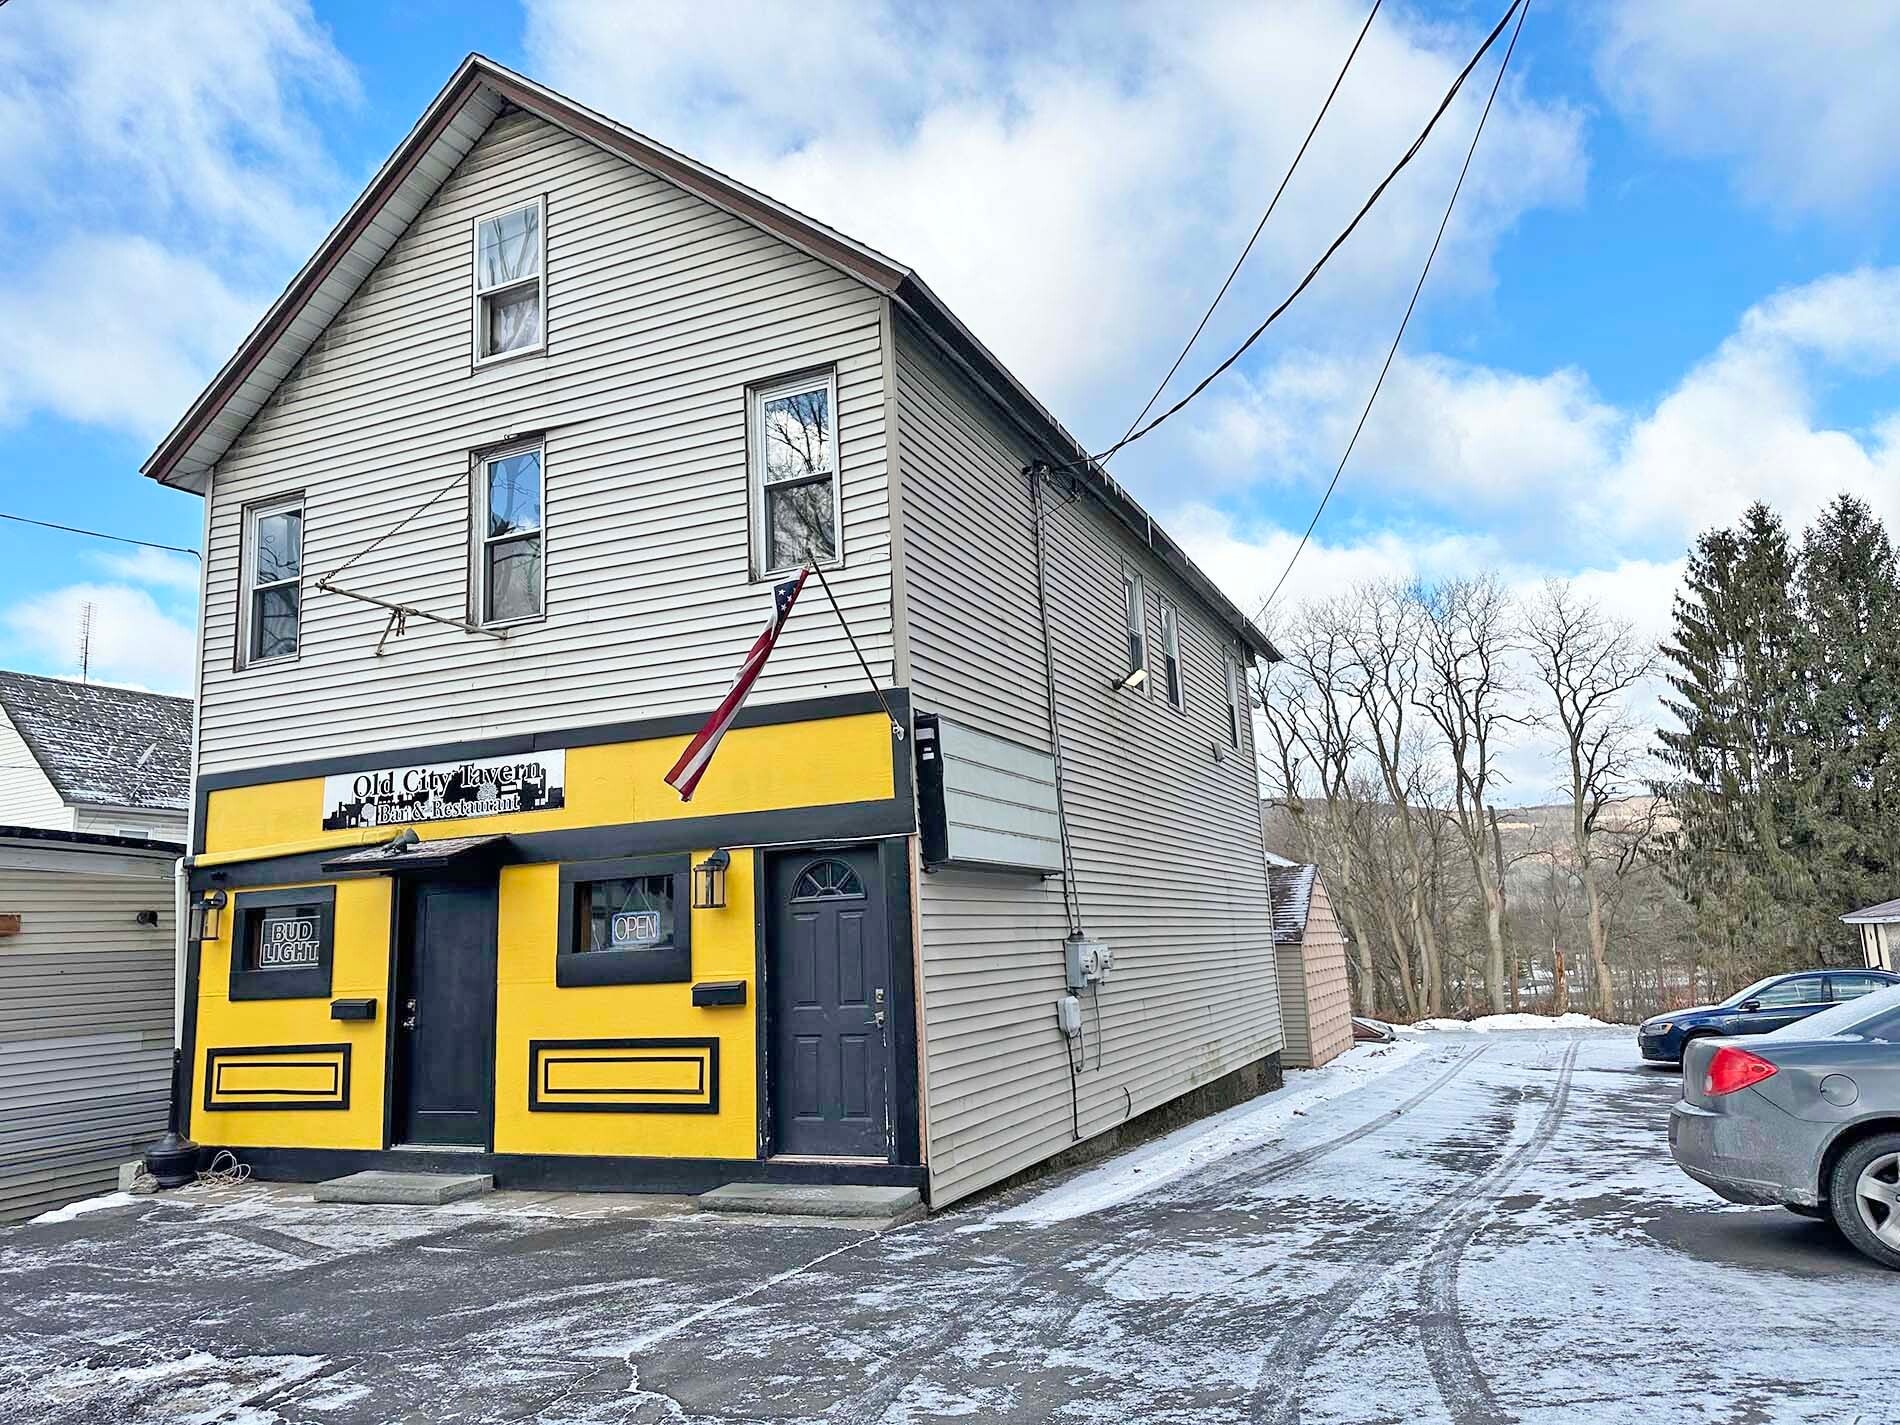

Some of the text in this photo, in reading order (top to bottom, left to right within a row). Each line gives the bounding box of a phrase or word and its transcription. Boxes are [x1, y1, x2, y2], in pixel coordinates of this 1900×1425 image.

[353, 762, 542, 799] Old City Tavern
[379, 795, 520, 824] Bar & Restaurant
[272, 921, 312, 942] BUD
[615, 916, 656, 940] OPEN
